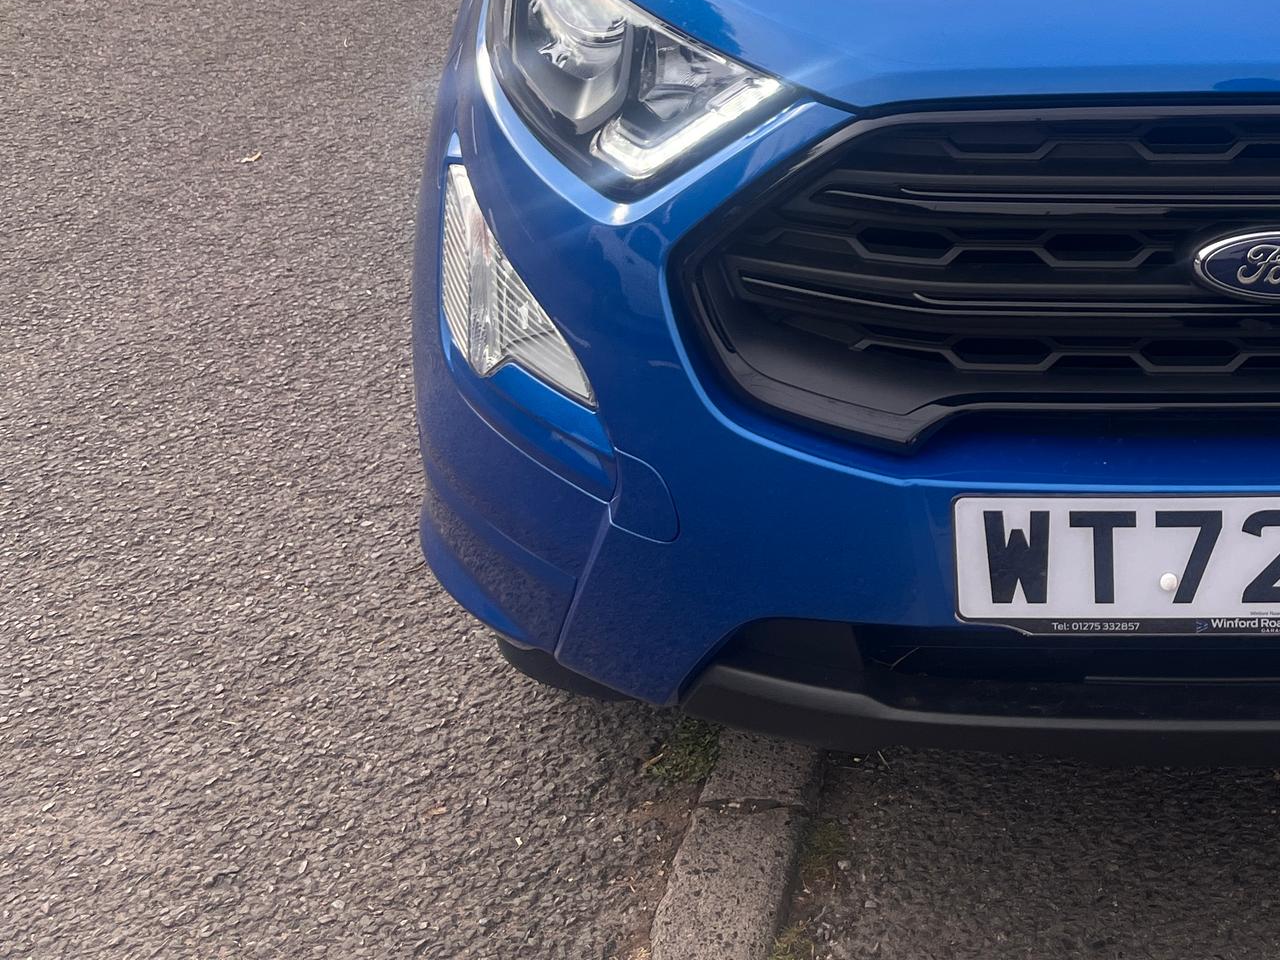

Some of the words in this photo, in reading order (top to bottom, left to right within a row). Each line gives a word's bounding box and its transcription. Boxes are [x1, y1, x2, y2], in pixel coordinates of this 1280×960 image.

[1051, 622, 1070, 631] Tel:
[1071, 622, 1101, 631] 01275
[1102, 622, 1140, 631] 332857
[1211, 618, 1259, 629] Winford
